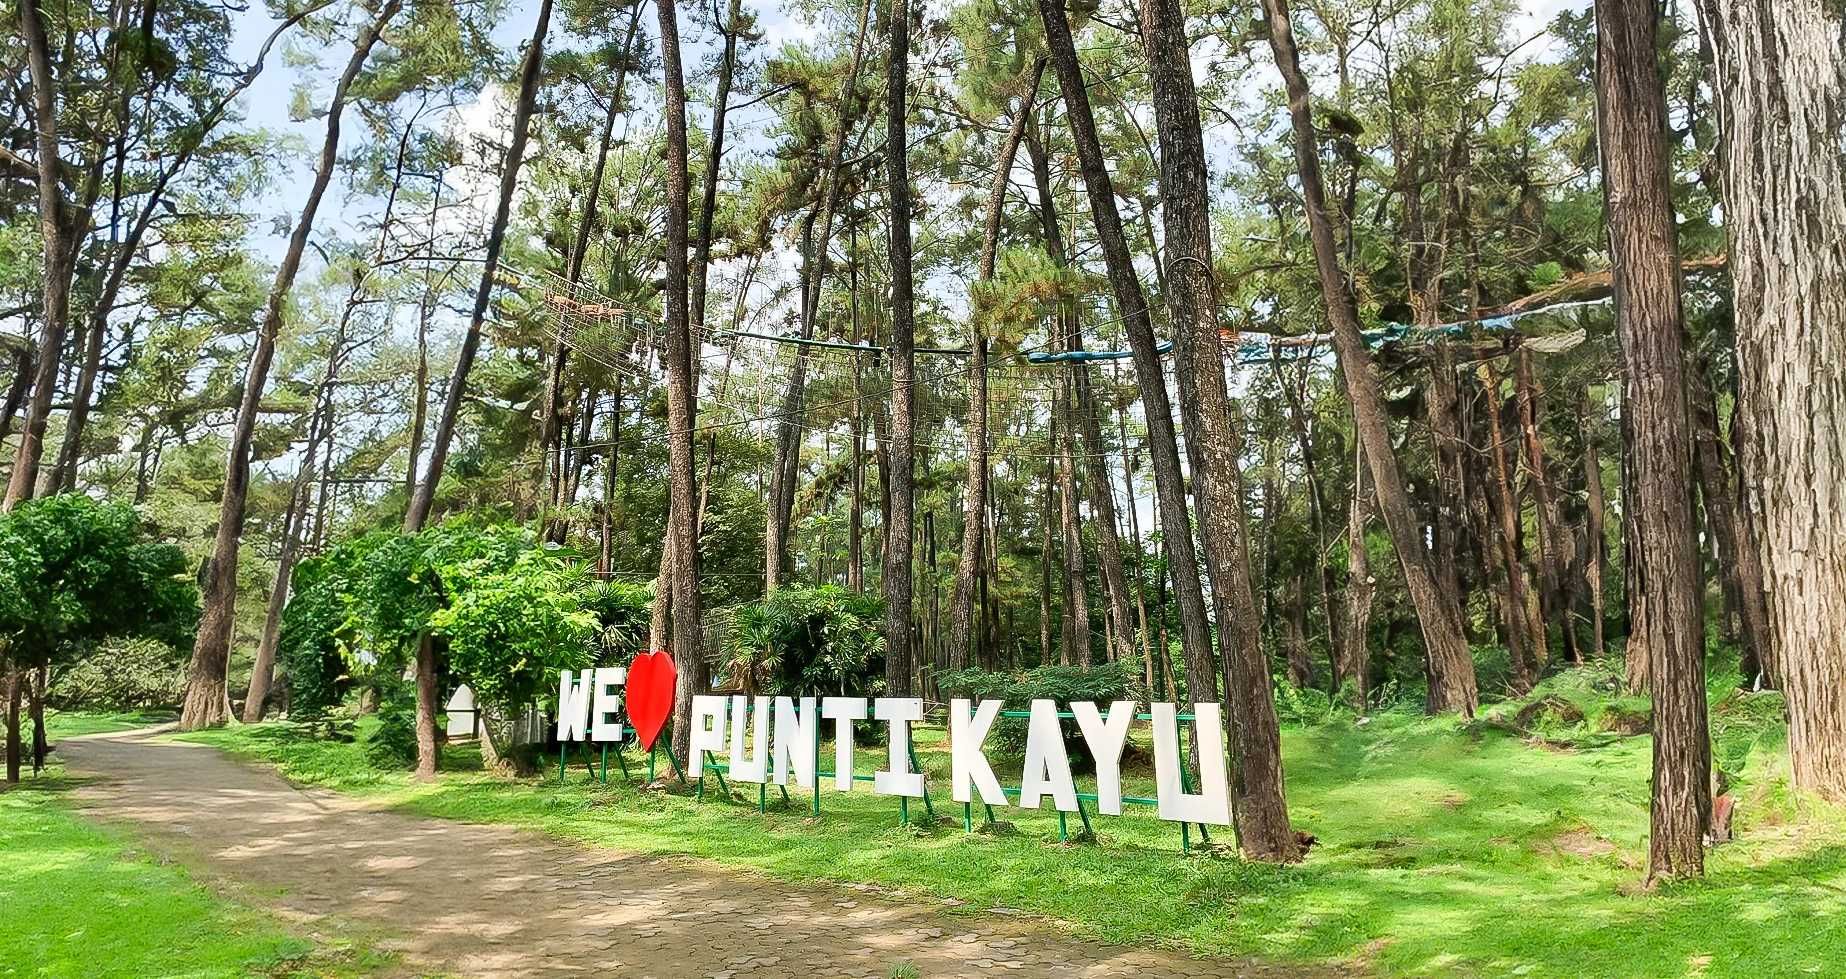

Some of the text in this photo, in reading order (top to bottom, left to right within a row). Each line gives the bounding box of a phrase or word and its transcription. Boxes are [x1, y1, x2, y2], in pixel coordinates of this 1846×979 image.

[557, 667, 1233, 826] WE PUNTI KAYU
